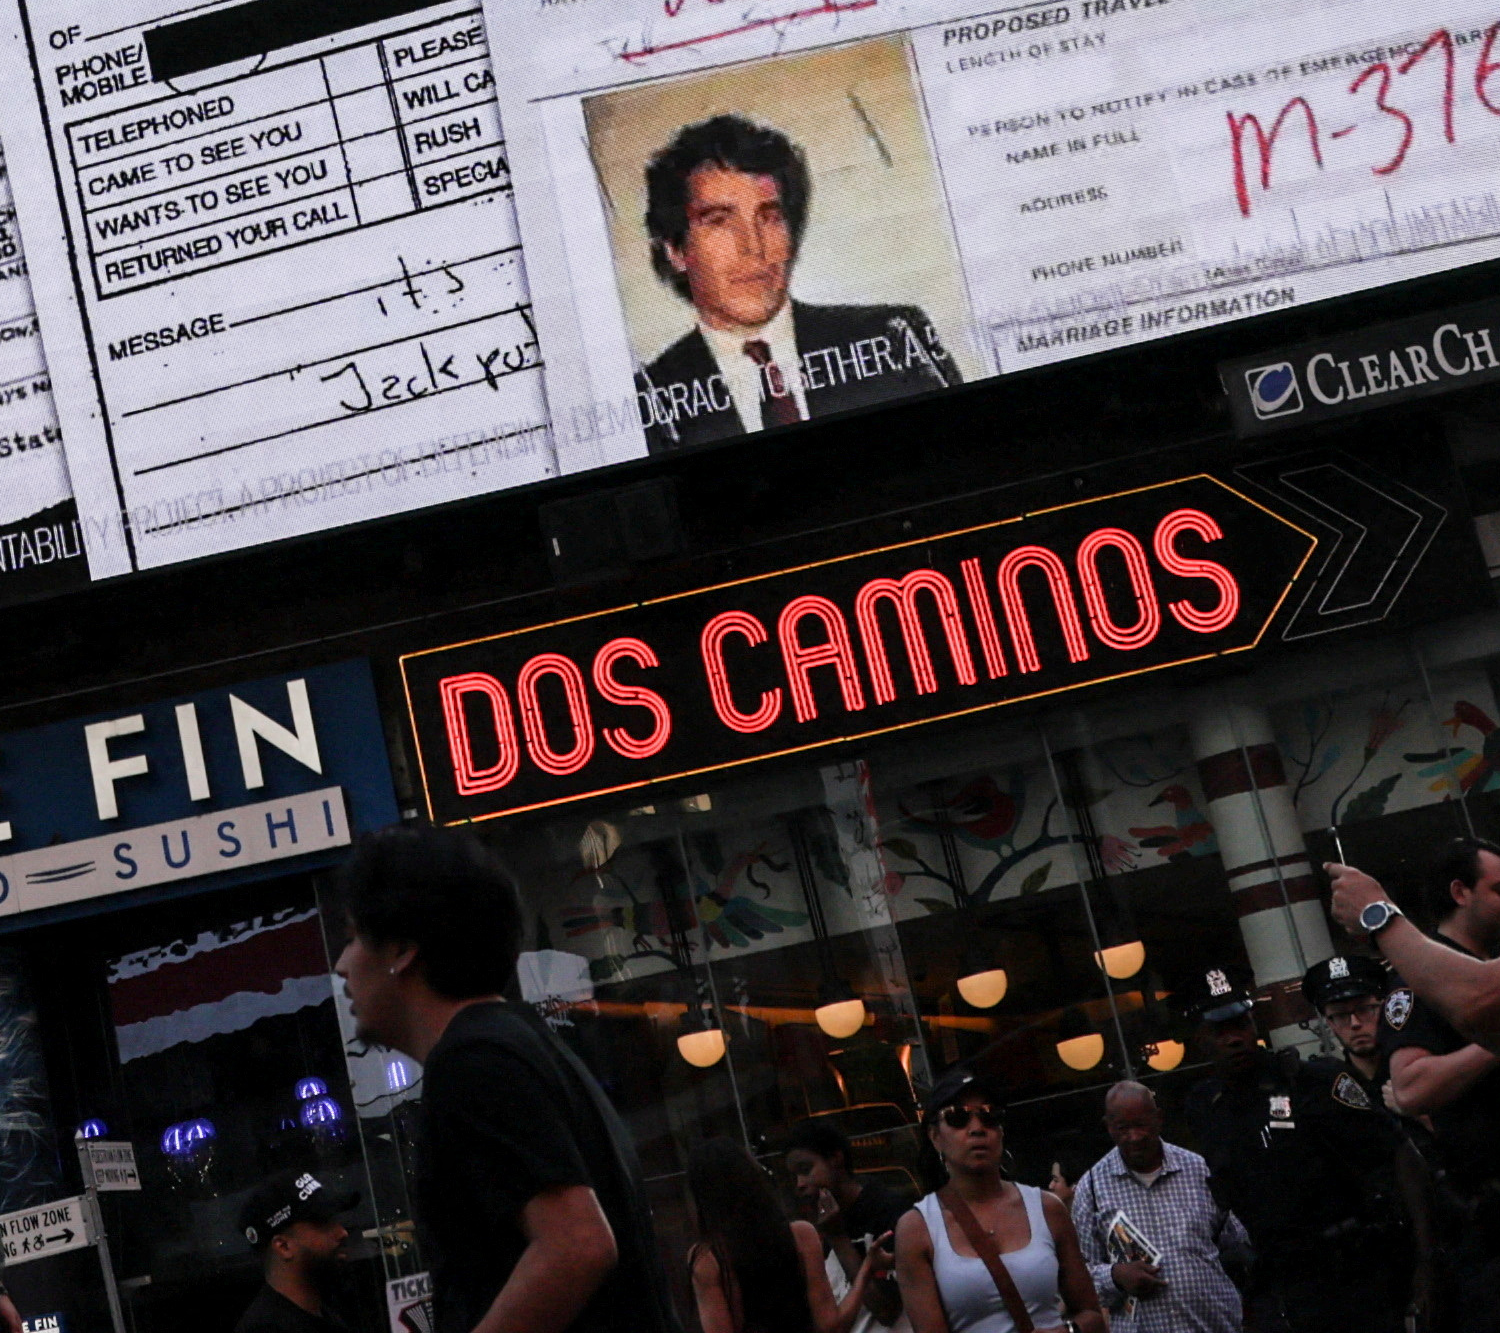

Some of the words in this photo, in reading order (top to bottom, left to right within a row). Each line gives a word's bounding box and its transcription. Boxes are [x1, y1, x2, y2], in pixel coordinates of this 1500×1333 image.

[392, 26, 484, 67] PLEASE
[942, 5, 1074, 47] PROPOSED
[402, 85, 460, 111] WILL
[76, 95, 236, 155] TELEPHONED
[414, 119, 482, 155] RUSH
[107, 313, 228, 363] MESSAGE
[438, 635, 672, 799] DOS
[699, 506, 1241, 735] CAMINOS
[83, 676, 324, 822] FIN
[112, 798, 339, 883] SUSHI
[10, 1211, 40, 1234] FLOW
[41, 1205, 73, 1228] ZONE
